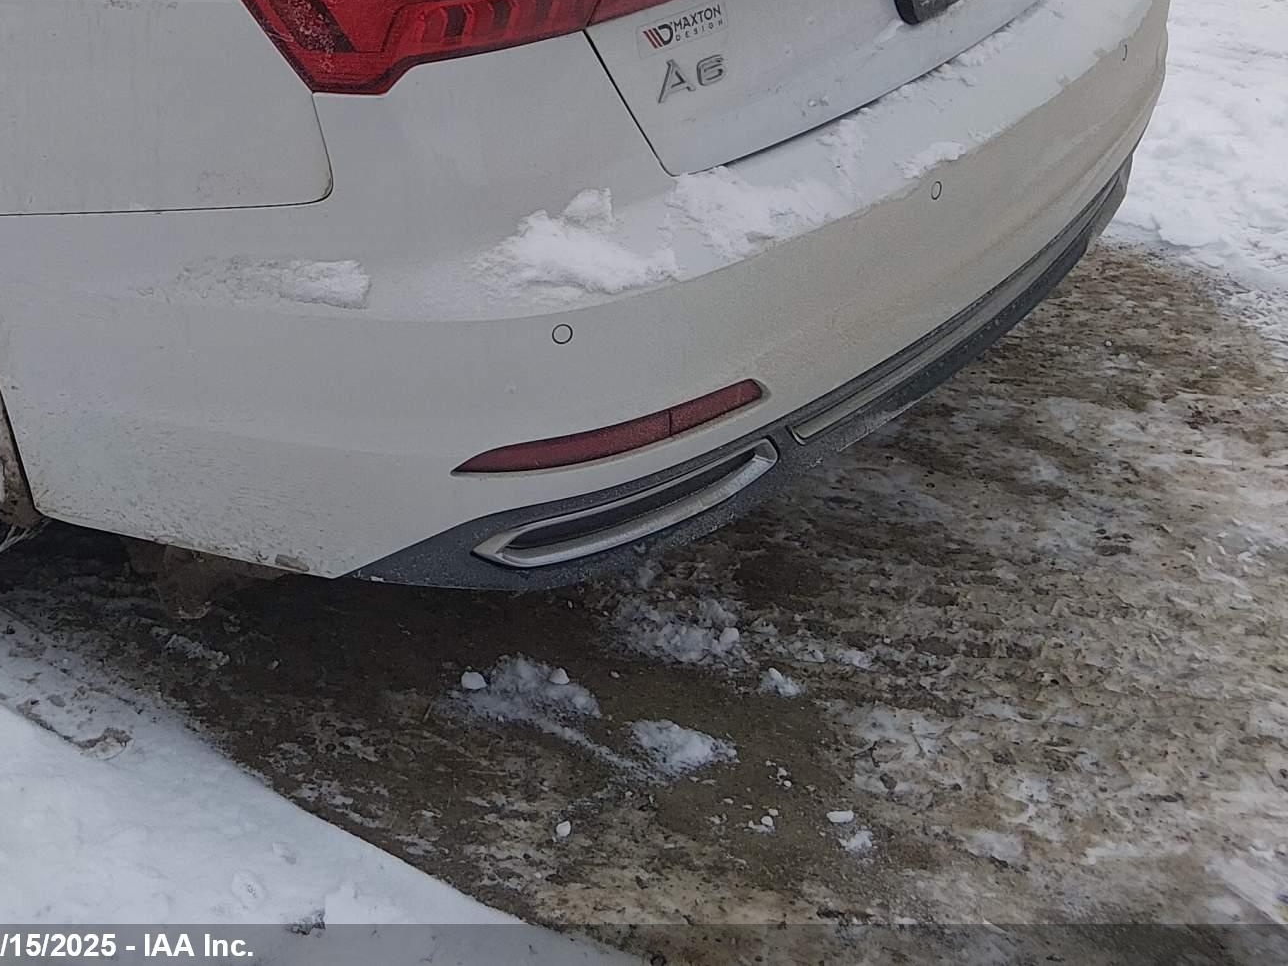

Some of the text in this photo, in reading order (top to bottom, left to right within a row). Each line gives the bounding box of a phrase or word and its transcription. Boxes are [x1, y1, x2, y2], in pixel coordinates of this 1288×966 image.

[673, 3, 721, 32] MAXTON
[675, 19, 723, 42] DESIGN
[657, 54, 725, 104] A6
